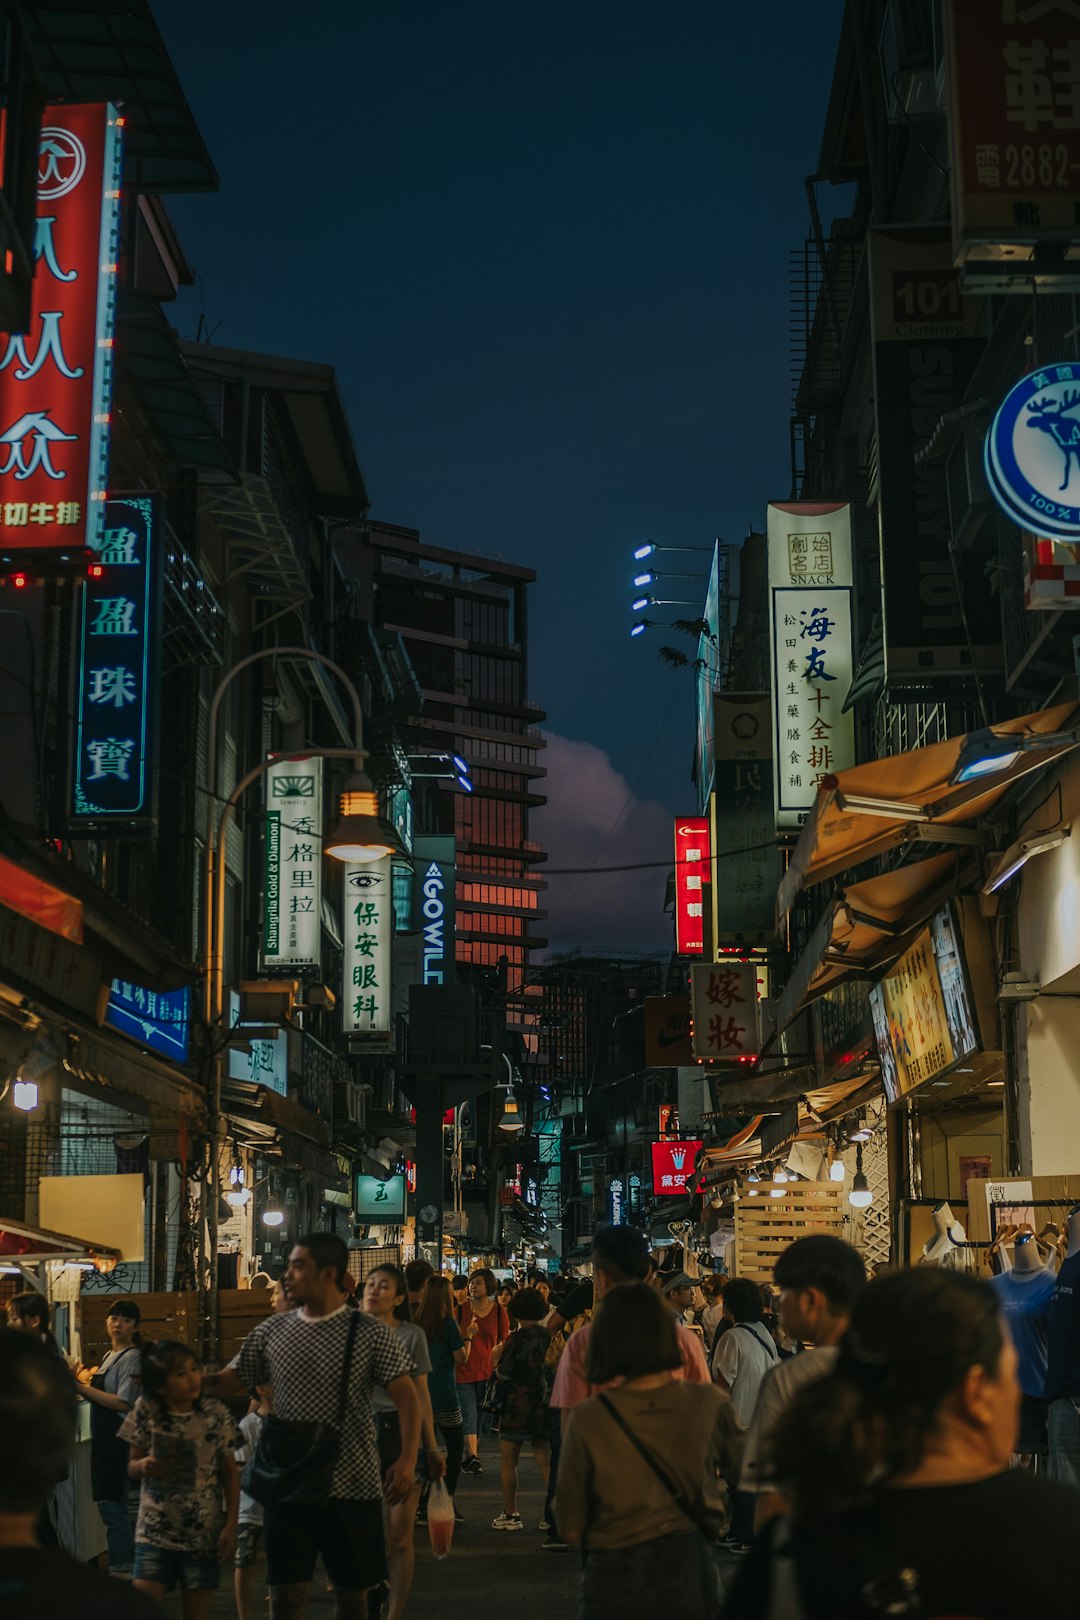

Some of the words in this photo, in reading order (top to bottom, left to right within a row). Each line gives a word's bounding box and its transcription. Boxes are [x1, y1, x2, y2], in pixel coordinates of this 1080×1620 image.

[897, 280, 961, 315] 101
[895, 323, 965, 338] Clothing
[0, 502, 81, 527] 切牛排
[790, 574, 834, 585] SNACK
[86, 526, 141, 782] 盈盈珠寶
[734, 749, 758, 759] Shop
[268, 863, 278, 873] &
[284, 816, 316, 914] 香格里拉
[268, 874, 278, 899] Gold
[267, 900, 279, 949] Shangrila
[352, 902, 380, 1021] 保安眼科
[661, 1174, 691, 1188] 黛安
